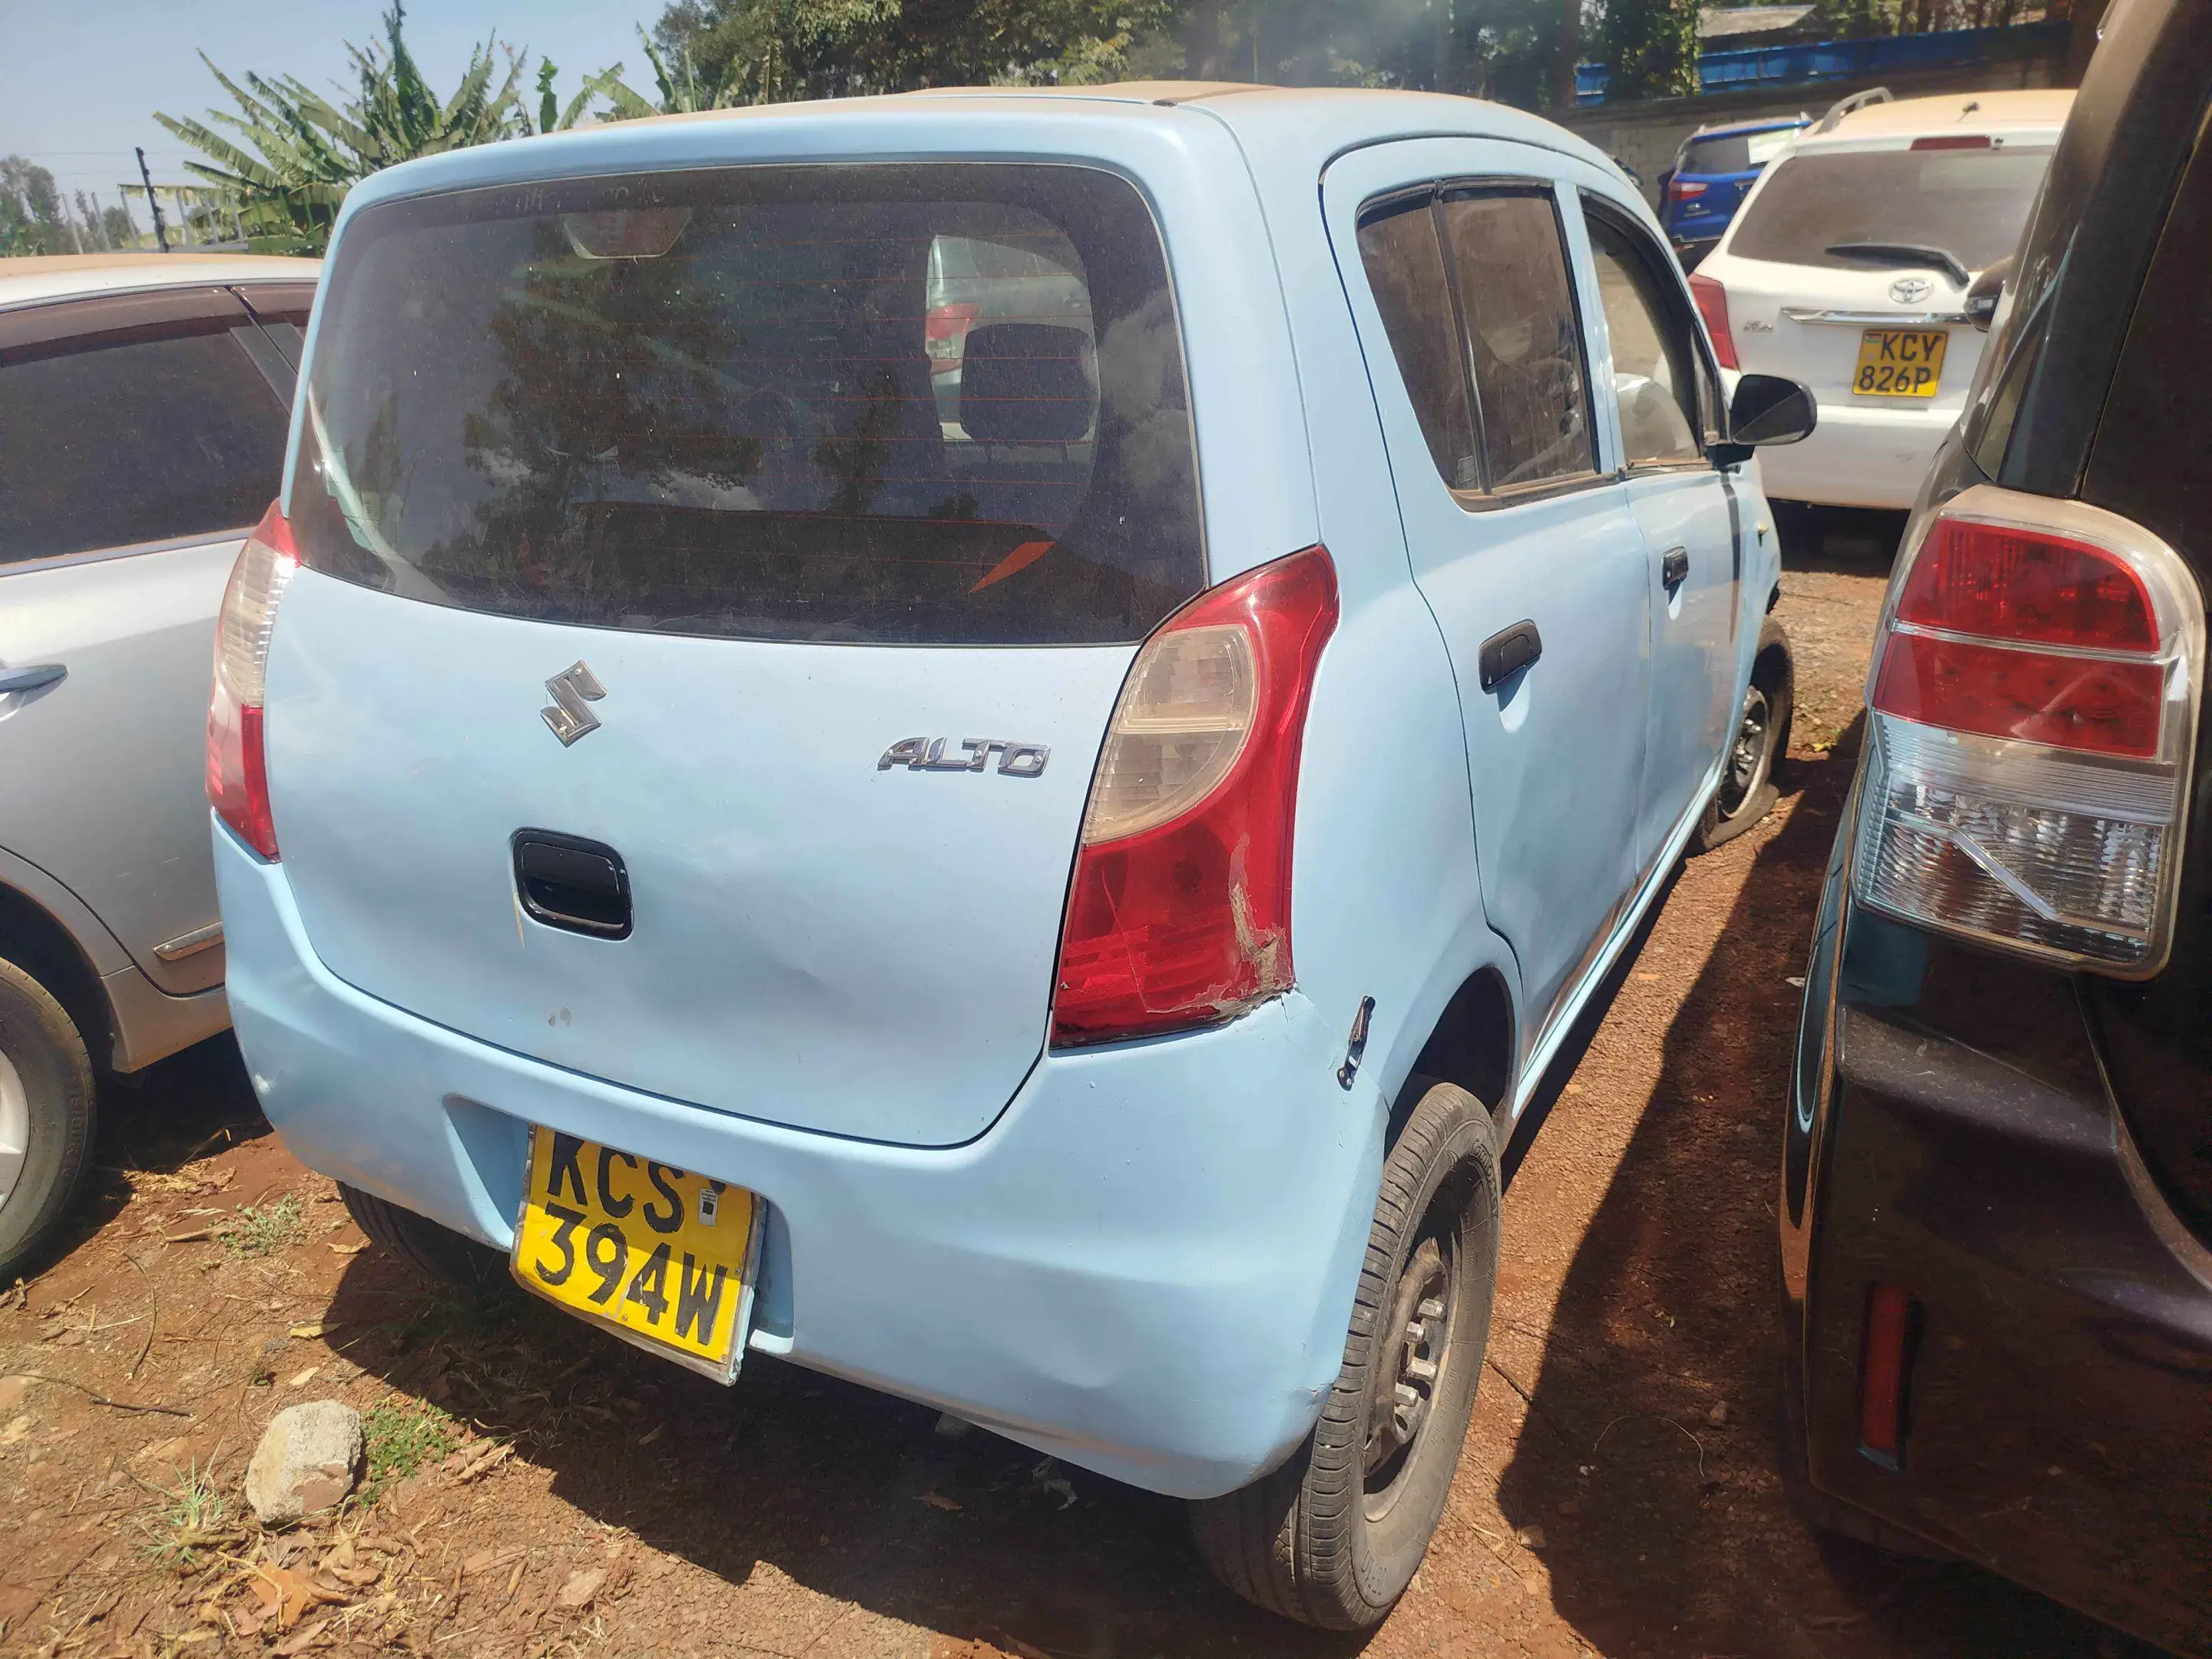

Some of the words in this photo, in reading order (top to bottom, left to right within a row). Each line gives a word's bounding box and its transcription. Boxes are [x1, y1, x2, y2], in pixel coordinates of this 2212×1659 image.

[1880, 333, 1940, 363] KCY
[1858, 366, 1932, 394] 826P
[877, 736, 1051, 779] ALTO
[547, 1131, 686, 1234] KCS
[534, 1201, 729, 1346] 394W
